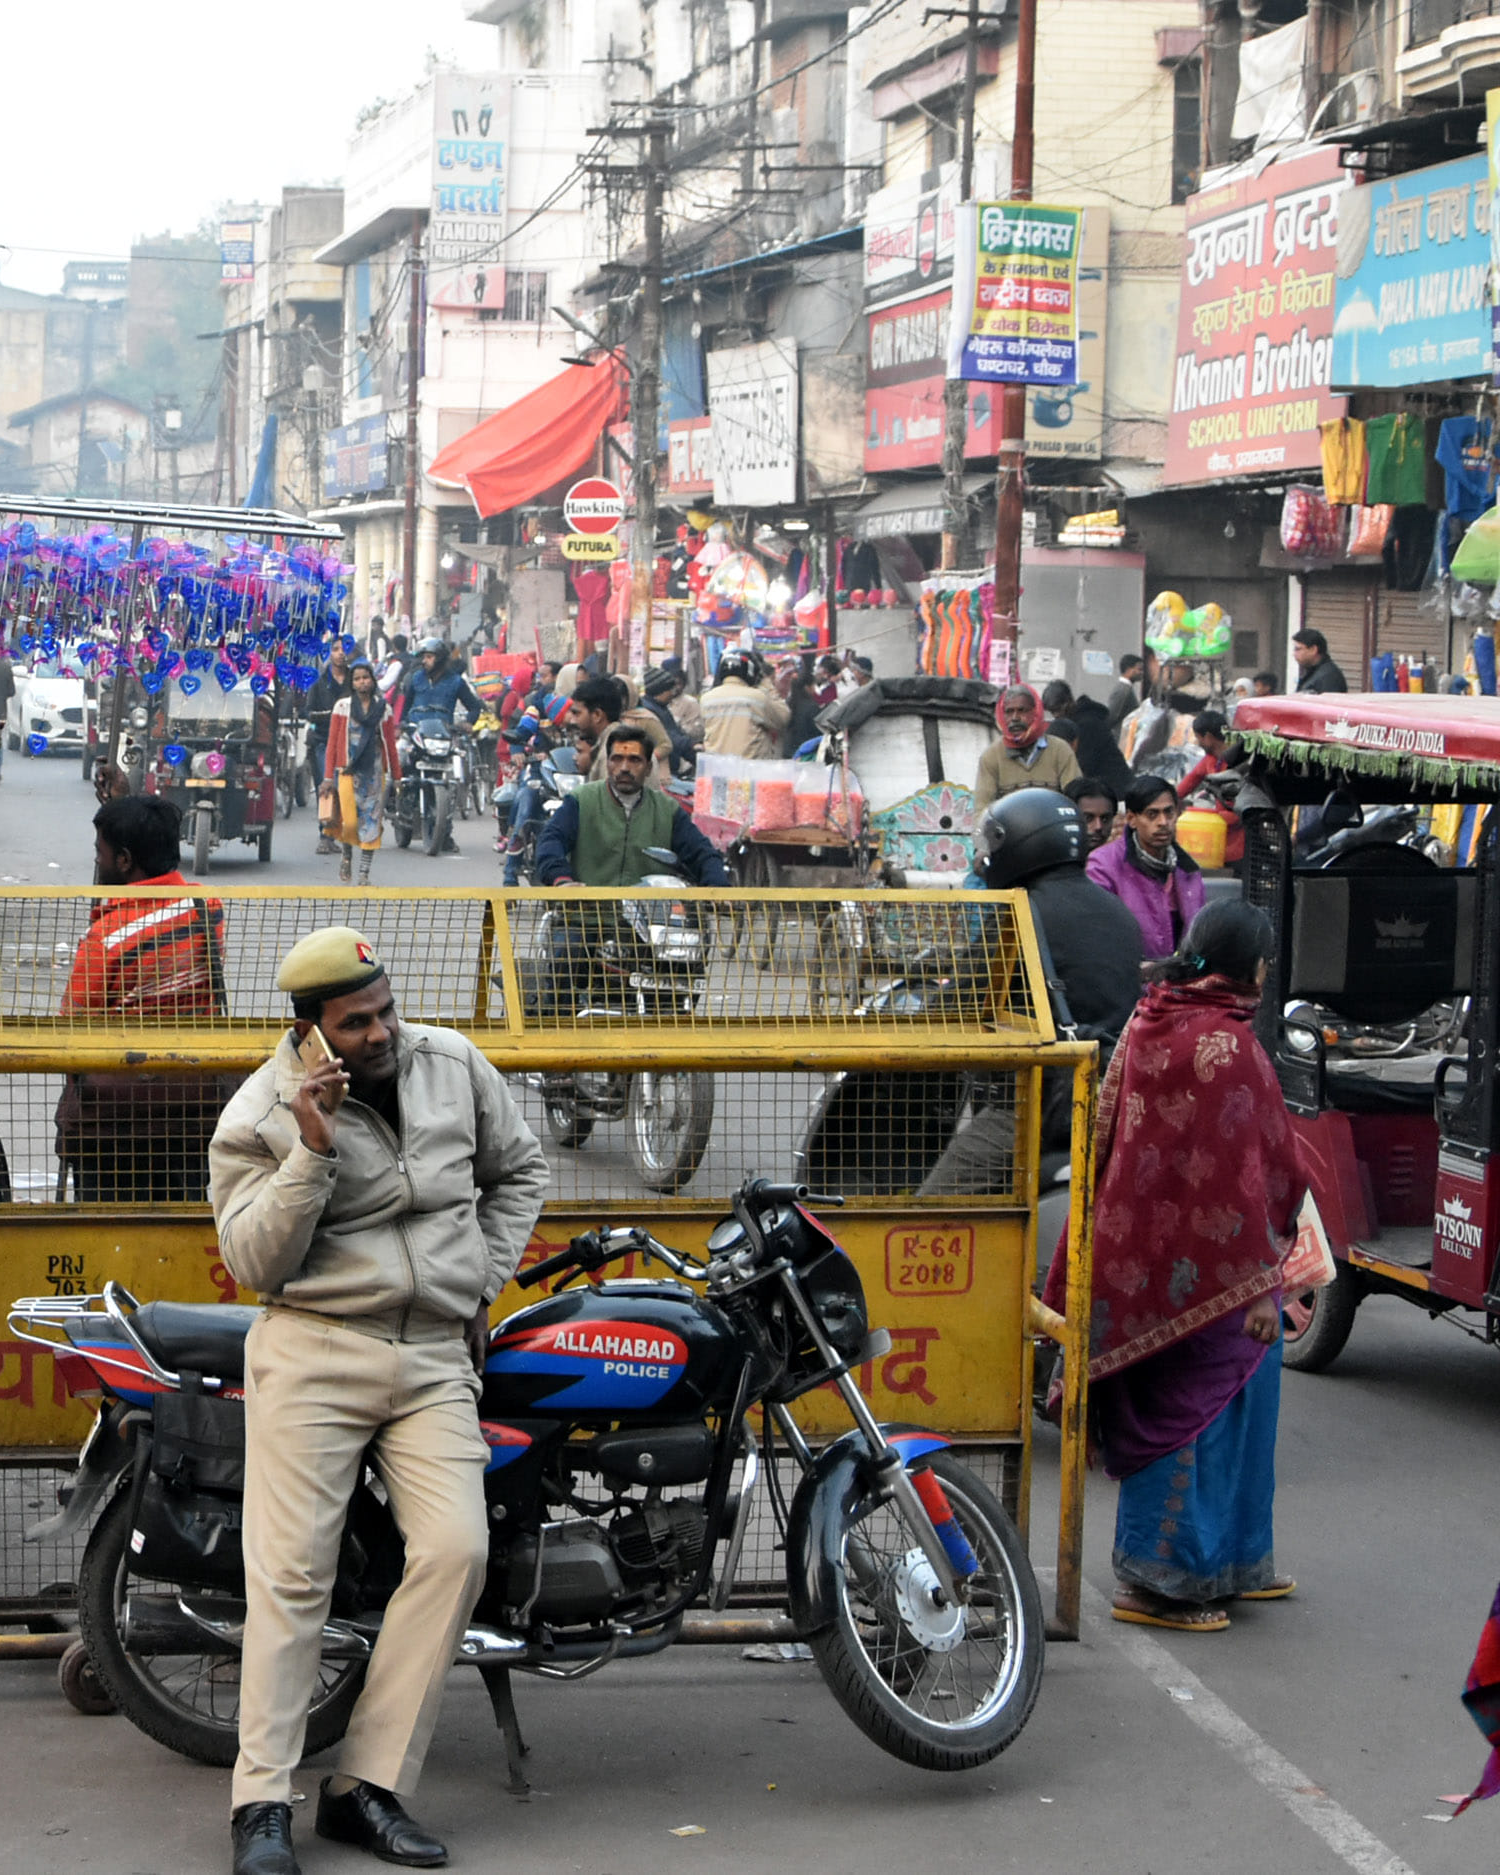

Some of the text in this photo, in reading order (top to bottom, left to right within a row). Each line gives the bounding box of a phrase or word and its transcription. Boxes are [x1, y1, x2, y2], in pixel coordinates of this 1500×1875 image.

[436, 139, 505, 172] टण्डन
[981, 206, 1075, 252] क्रिसमस
[1374, 181, 1425, 258] भोला
[1427, 183, 1471, 245] नाथ
[1186, 200, 1269, 286] खन्ना
[980, 279, 1070, 307] राष्ट्रीय ध्वज
[1192, 294, 1231, 346] स्कूल
[1258, 277, 1278, 320] के
[1280, 267, 1334, 318] विक्रेता
[1033, 358, 1063, 377] चौक
[1173, 349, 1246, 414] Khanna
[1187, 398, 1318, 449] SCHOOL UNIFORM
[565, 502, 622, 514] Hawkins
[567, 541, 613, 552] FUTURA
[1357, 723, 1445, 754] DUKE AUTO INDIA
[1434, 1213, 1483, 1249] TYSONN
[1440, 1238, 1473, 1260] DELUXE
[47, 1255, 84, 1275] PRJ
[899, 1263, 956, 1286] 2018
[46, 1278, 87, 1297] 703
[553, 1331, 676, 1360] ALLAHABAD
[603, 1361, 670, 1379] POLICE
